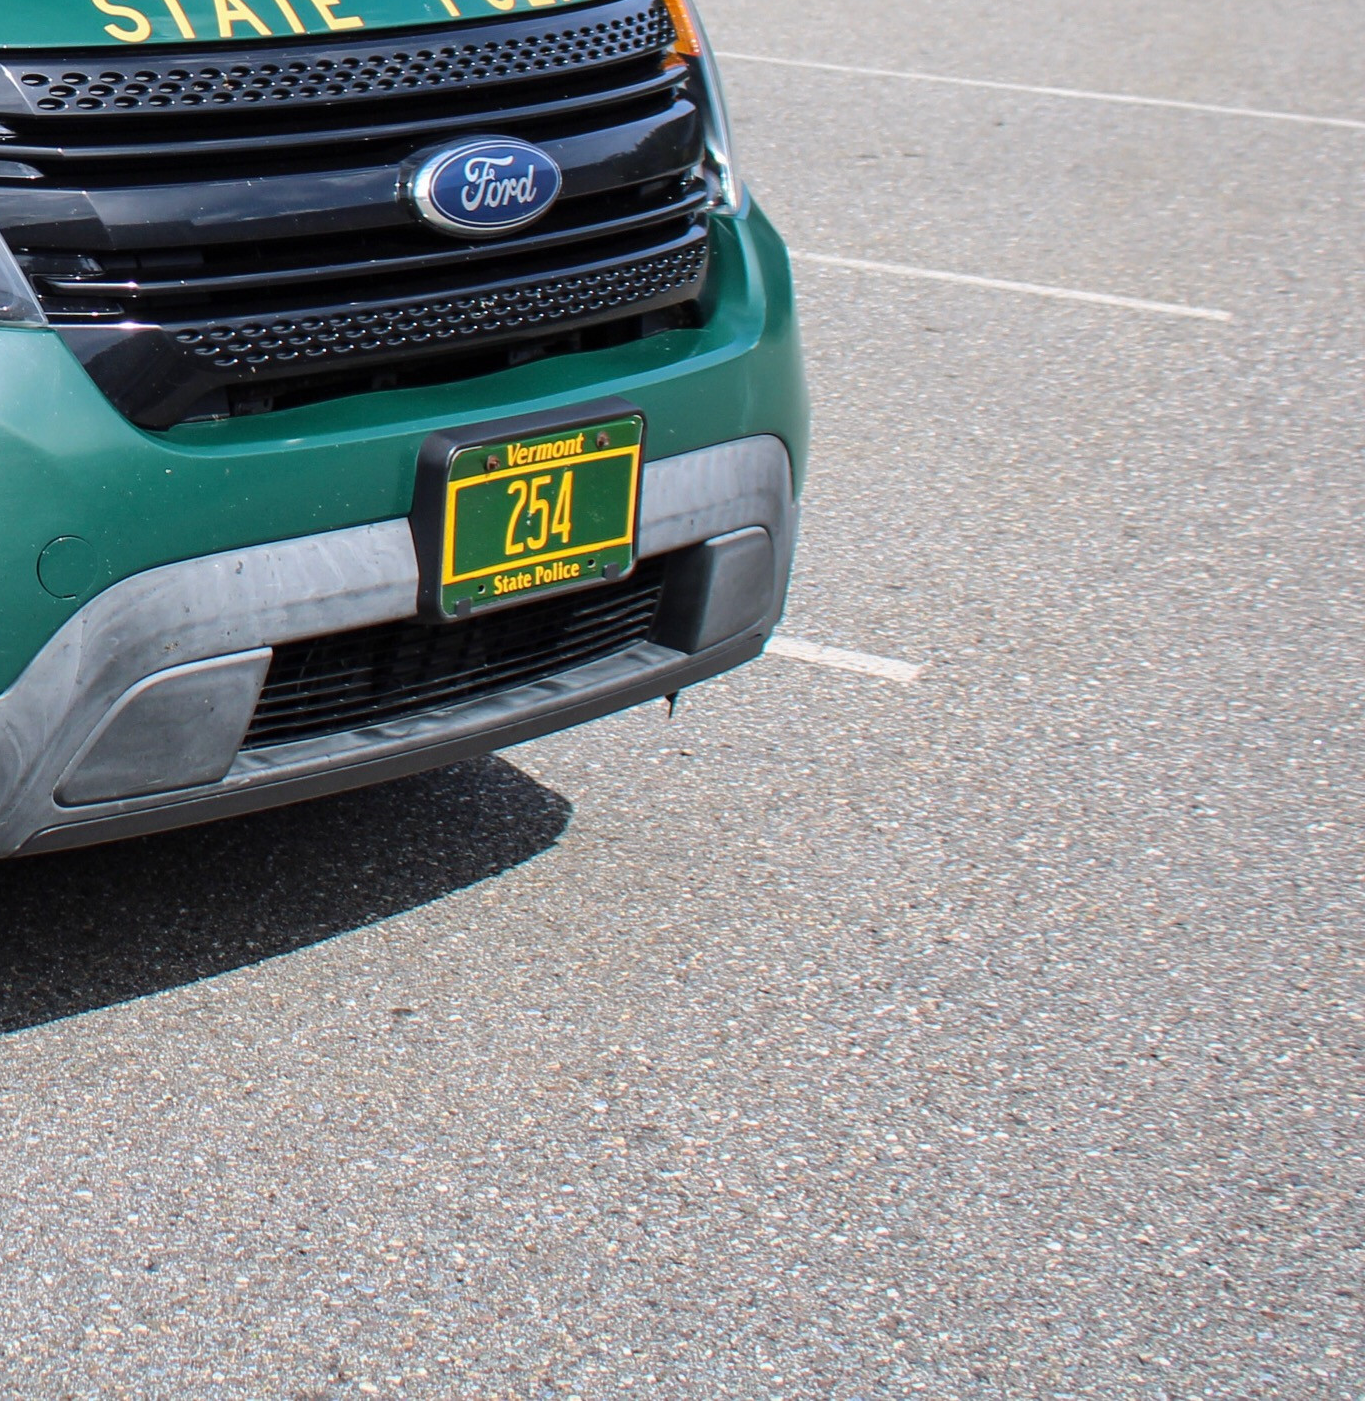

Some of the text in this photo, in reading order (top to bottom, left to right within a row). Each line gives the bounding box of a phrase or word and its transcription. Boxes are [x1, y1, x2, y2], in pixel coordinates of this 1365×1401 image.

[460, 154, 535, 211] Ford
[506, 432, 585, 467] Vermont
[504, 470, 574, 556] 254
[493, 562, 580, 596] State Police
